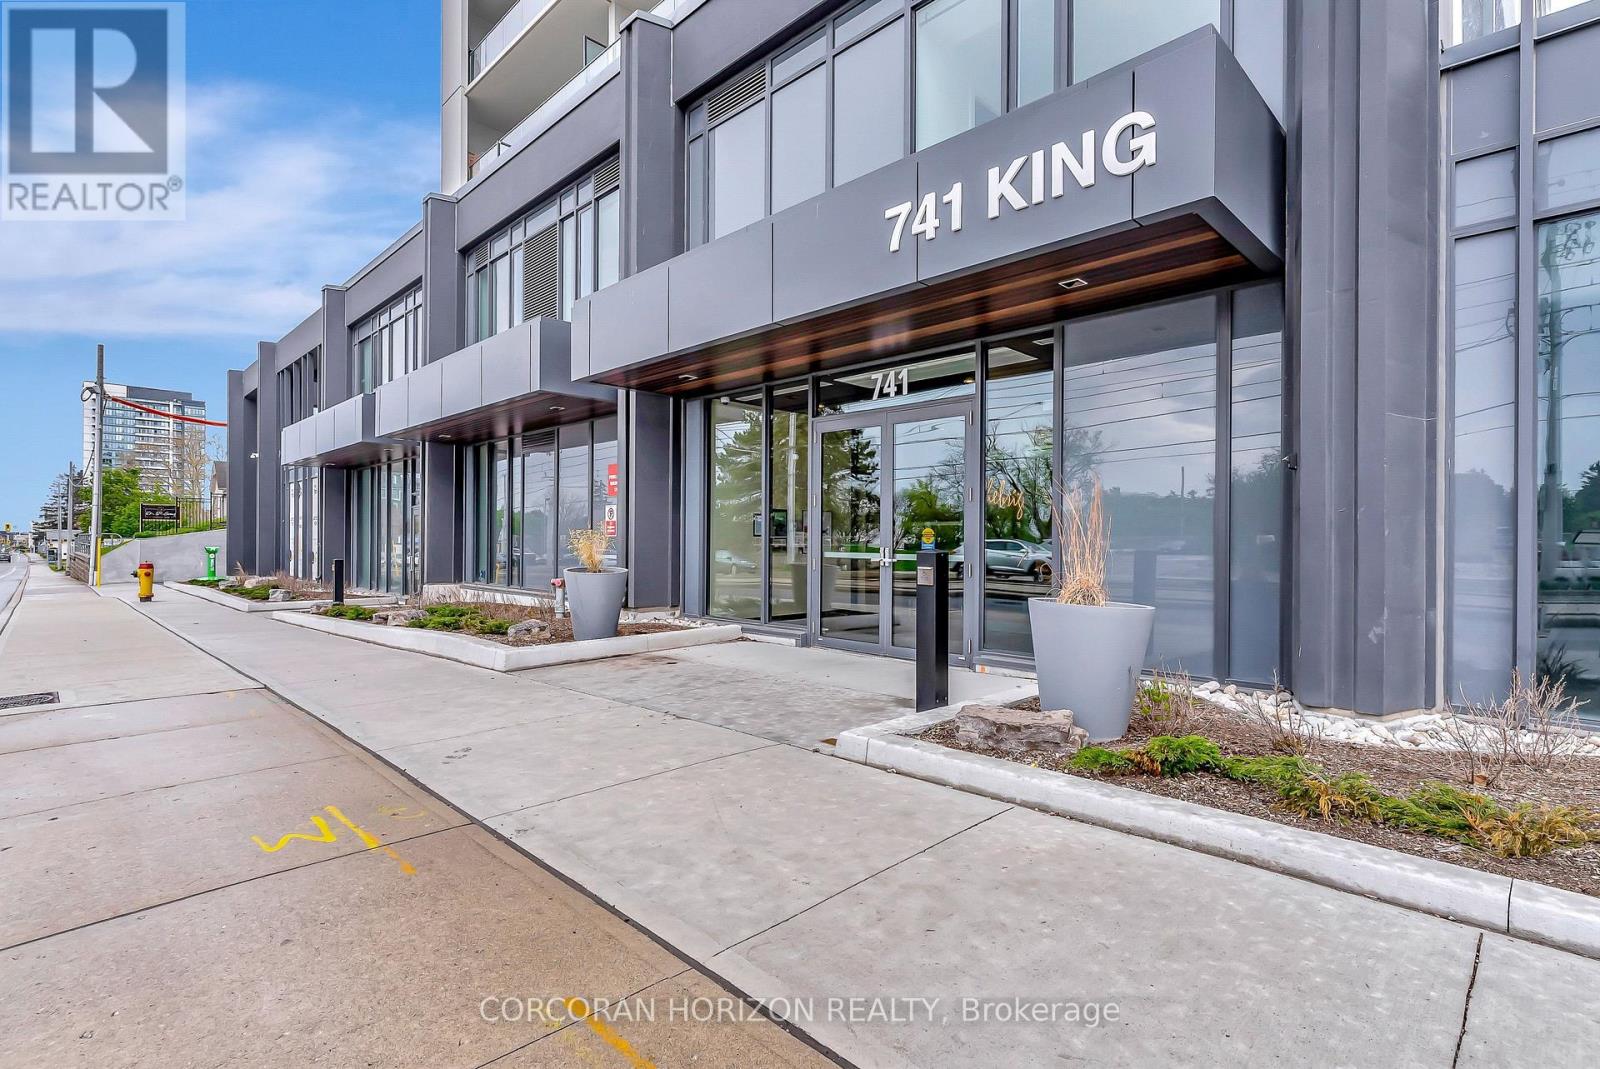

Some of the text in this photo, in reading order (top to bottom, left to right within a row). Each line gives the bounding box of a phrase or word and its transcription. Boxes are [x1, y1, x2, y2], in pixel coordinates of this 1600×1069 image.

[884, 111, 1157, 253] 741 KING
[871, 368, 908, 400] 741
